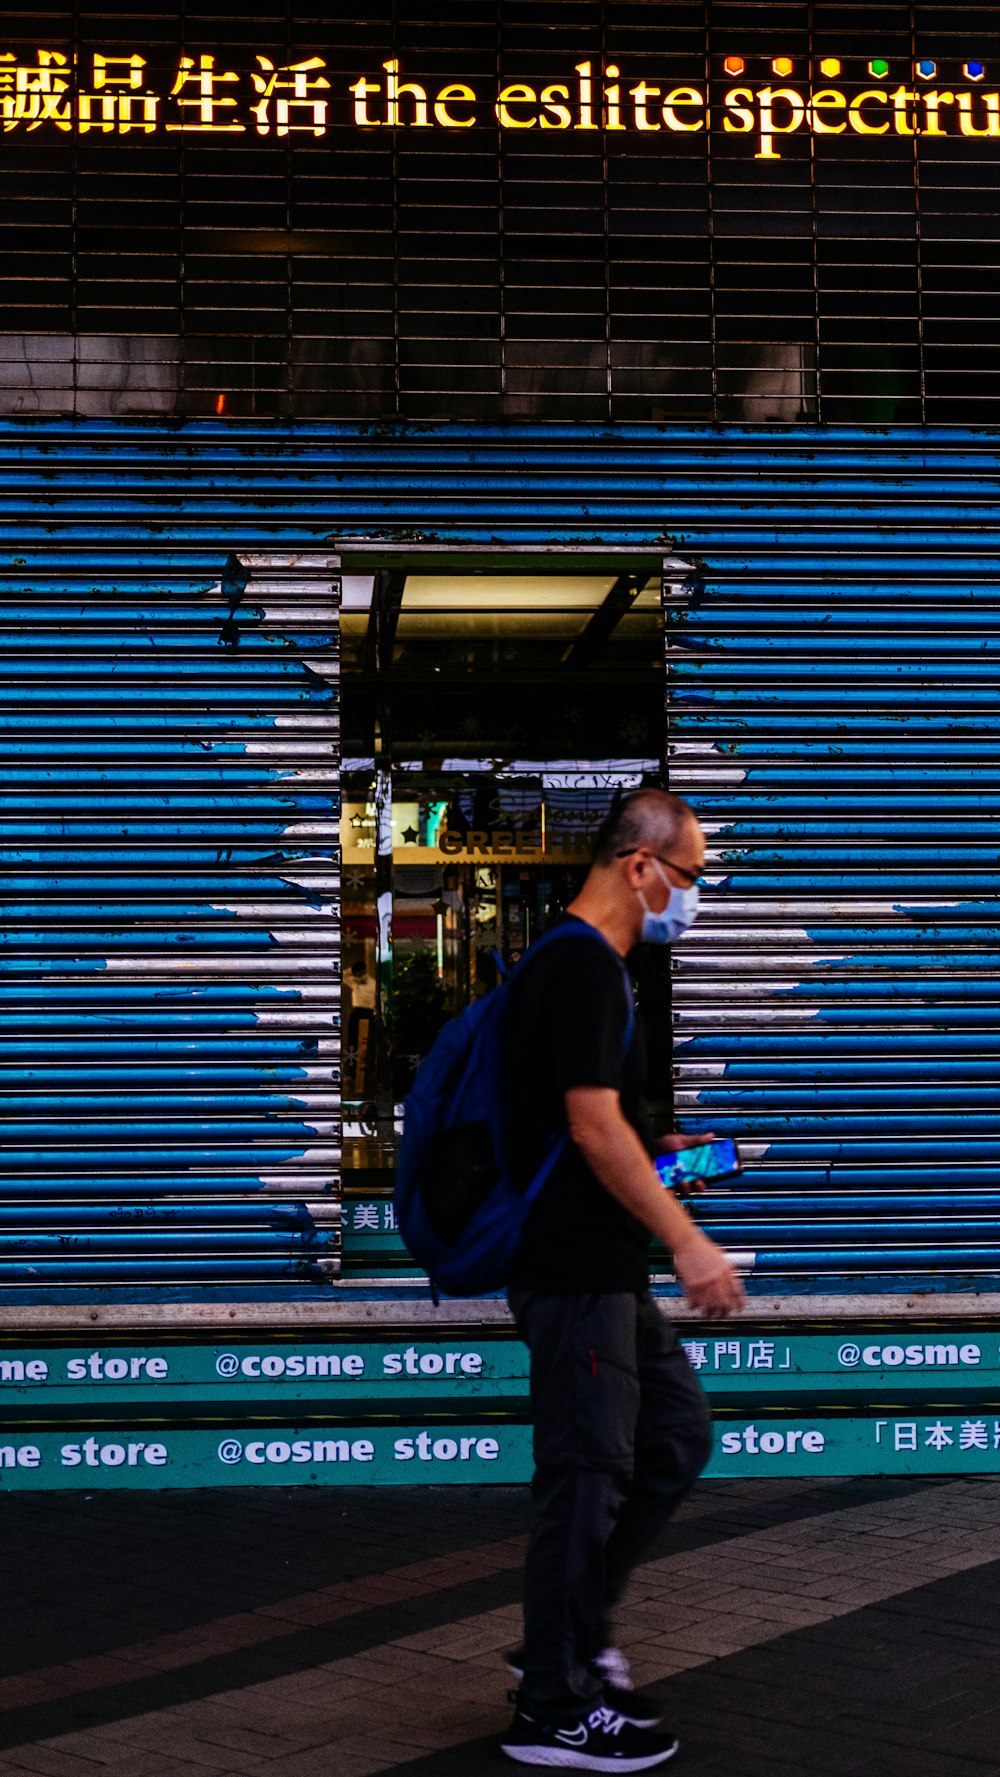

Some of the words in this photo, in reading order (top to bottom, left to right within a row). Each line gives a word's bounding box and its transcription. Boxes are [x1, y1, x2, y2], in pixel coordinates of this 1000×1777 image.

[0, 49, 331, 136] 誠品生活
[349, 58, 477, 128] the
[495, 60, 704, 131] eslite
[723, 85, 1000, 159] spectru
[67, 1351, 168, 1379] store
[216, 1353, 364, 1377] @cosme
[383, 1347, 482, 1374] store
[838, 1343, 981, 1366] @cosme
[218, 1439, 374, 1464] @cosme
[394, 1431, 500, 1460] store
[722, 1425, 825, 1454] store
[875, 1420, 1000, 1451] 「日本美
[60, 1437, 167, 1466] store
